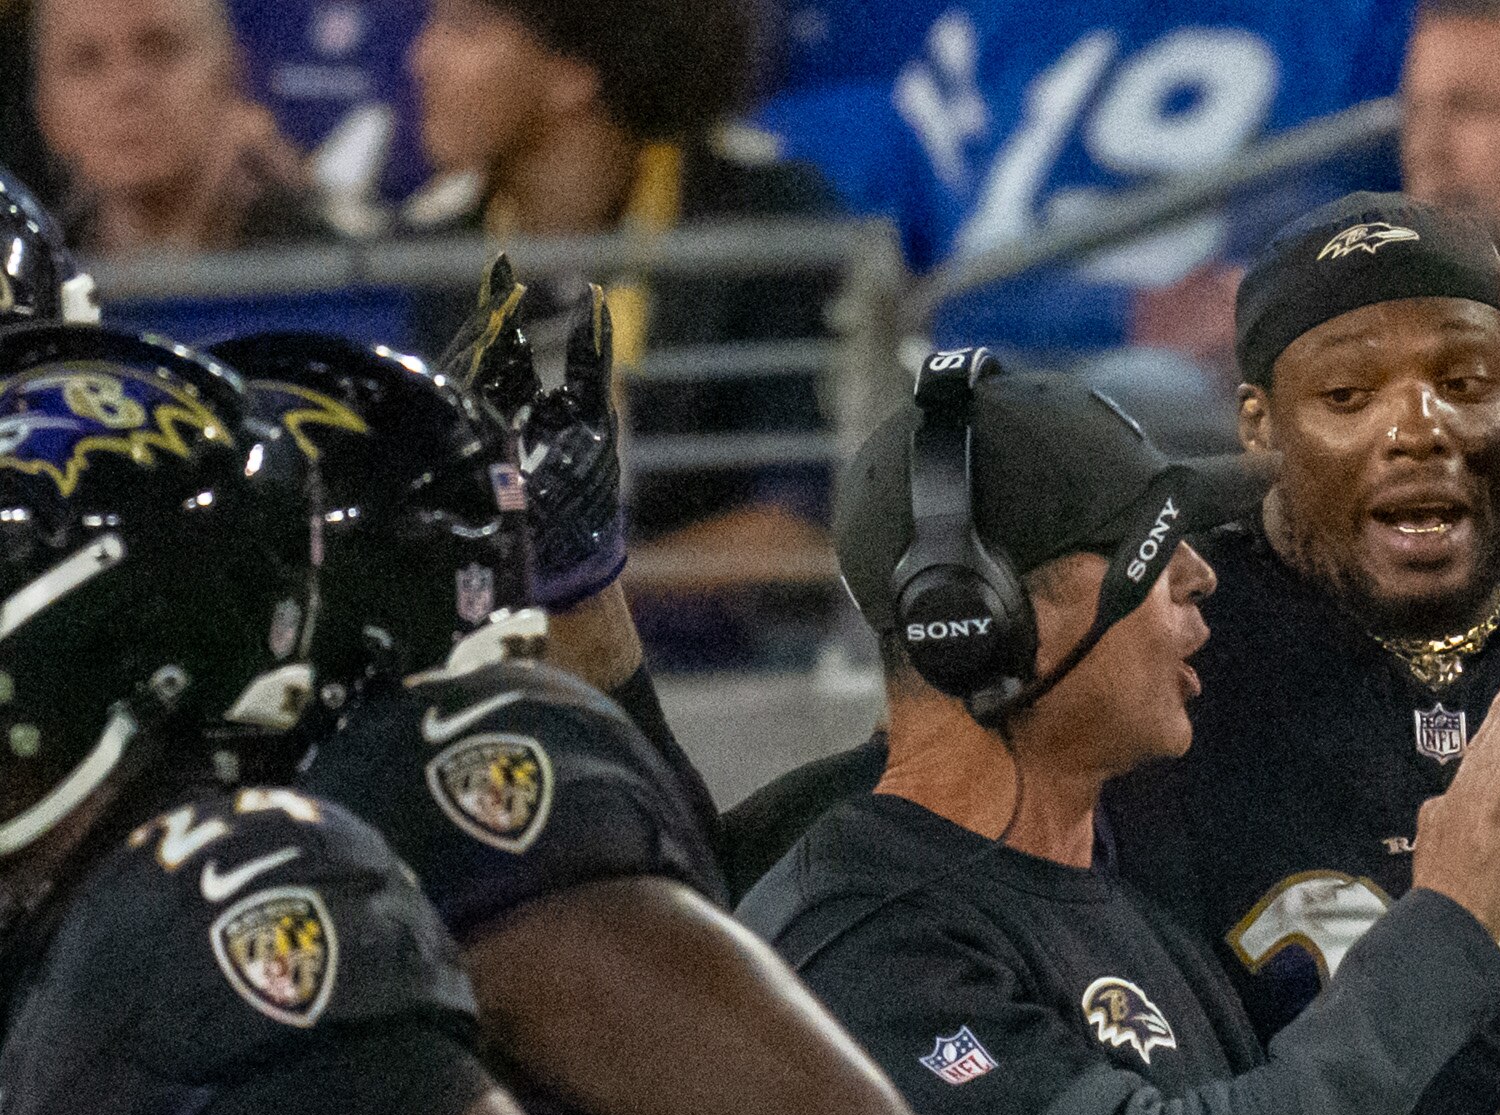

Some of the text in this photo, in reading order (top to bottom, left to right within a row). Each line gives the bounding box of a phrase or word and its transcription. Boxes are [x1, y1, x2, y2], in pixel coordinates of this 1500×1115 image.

[1127, 498, 1180, 583] SONY
[907, 617, 991, 641] SONY
[1424, 729, 1460, 753] NFL
[945, 1054, 990, 1081] NFL
